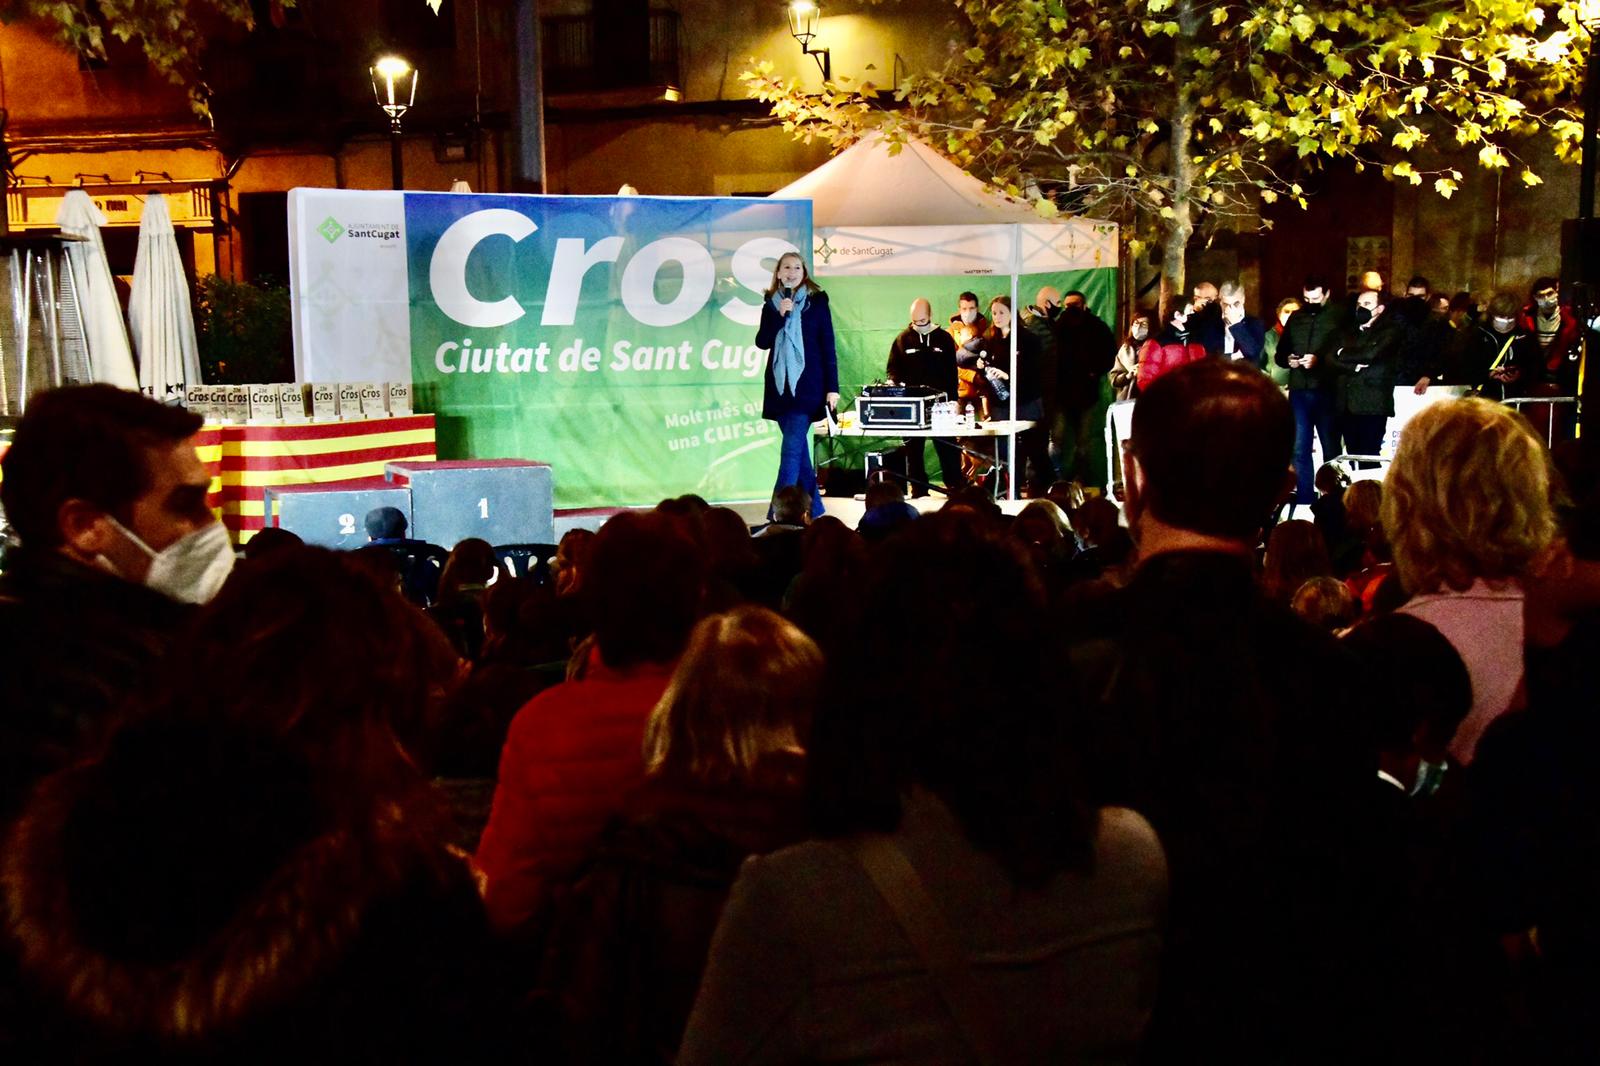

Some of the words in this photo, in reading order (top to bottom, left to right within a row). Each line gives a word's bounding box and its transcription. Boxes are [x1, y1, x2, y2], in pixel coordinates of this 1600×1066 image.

[348, 229, 400, 240] SantCugat
[840, 247, 851, 256] de
[852, 246, 894, 257] SantCugat
[429, 208, 800, 328] Cros
[435, 338, 551, 374] Ciutat
[558, 337, 601, 372] de
[610, 339, 693, 372] Sant
[701, 338, 771, 378] Cug
[188, 391, 209, 402] Cros
[211, 392, 226, 402] Cro
[227, 392, 247, 402] Cros
[281, 392, 301, 402] Cros
[314, 391, 333, 401] Cros
[340, 390, 358, 400] Cros
[361, 389, 380, 398] Cros
[390, 387, 407, 397] Cros
[252, 393, 274, 403] Cros
[664, 409, 703, 429] Molt
[706, 400, 740, 422] més
[743, 400, 764, 417] qu
[668, 435, 700, 451] una
[477, 497, 489, 519] 1
[338, 513, 356, 535] 2
